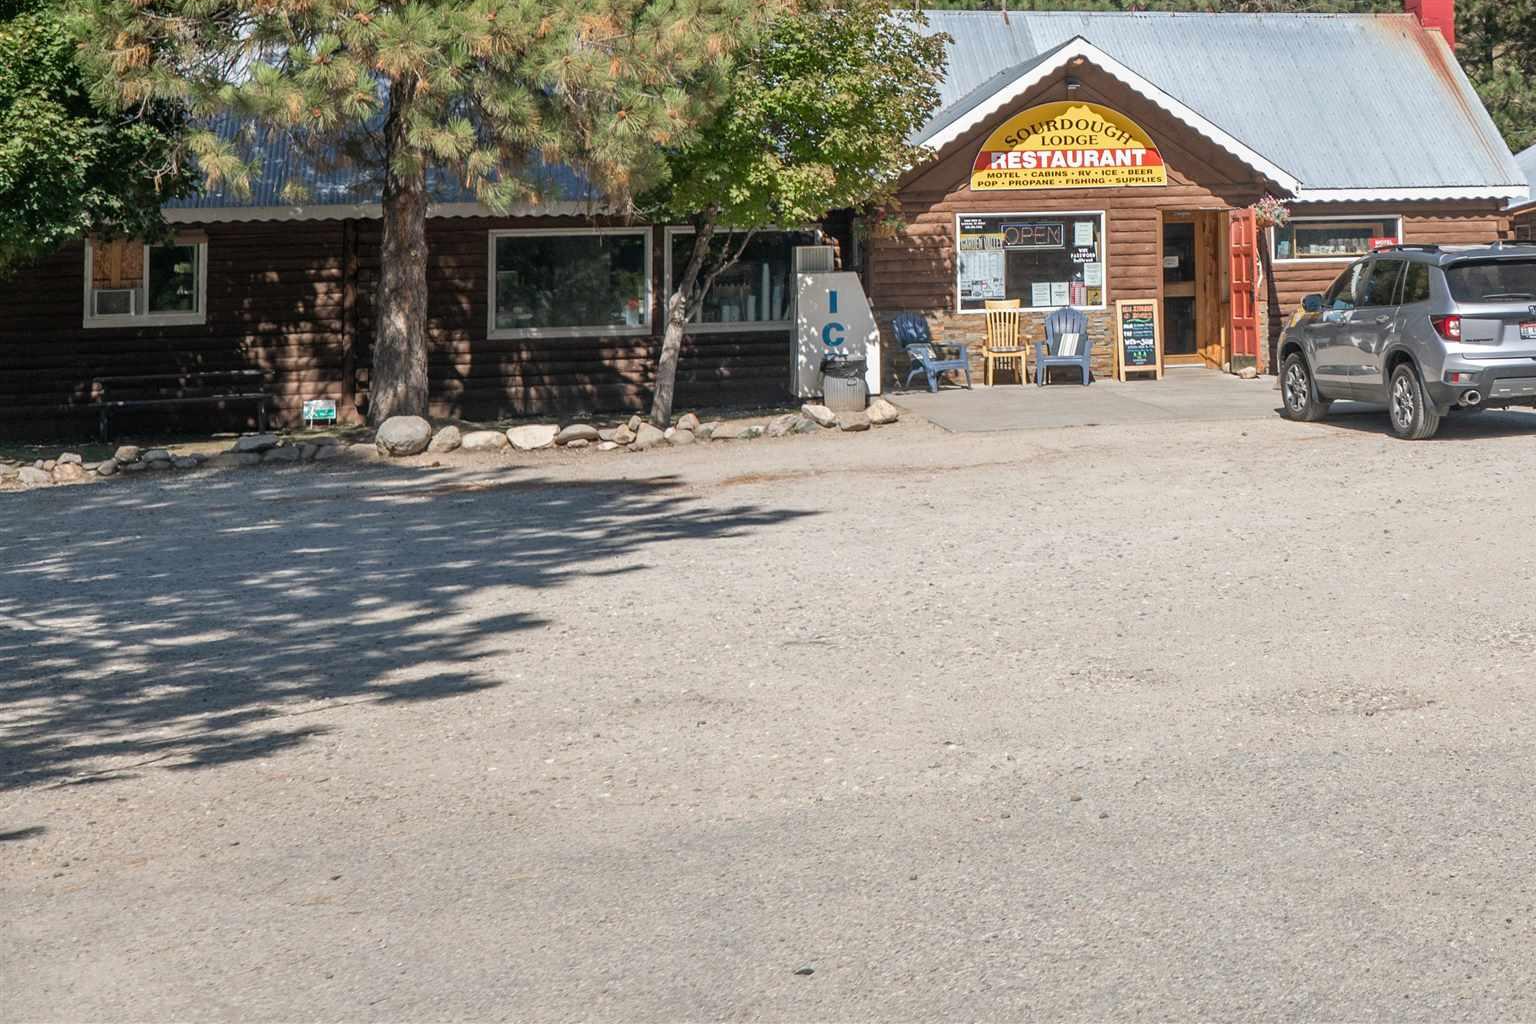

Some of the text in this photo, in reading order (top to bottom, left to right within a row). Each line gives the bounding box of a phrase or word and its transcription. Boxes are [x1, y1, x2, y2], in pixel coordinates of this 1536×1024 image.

[1005, 118, 1133, 148] SOURDOUGH
[1041, 134, 1099, 146] LODGE
[991, 149, 1147, 169] RESTAURANT
[987, 171, 1021, 179] MOTEL
[1031, 170, 1068, 178] CABINS
[1078, 169, 1092, 177] RV
[1128, 168, 1153, 176] BEER
[1008, 179, 1055, 187] PROPANE
[1065, 177, 1105, 185] FISHING
[1005, 226, 1060, 245] OPEN
